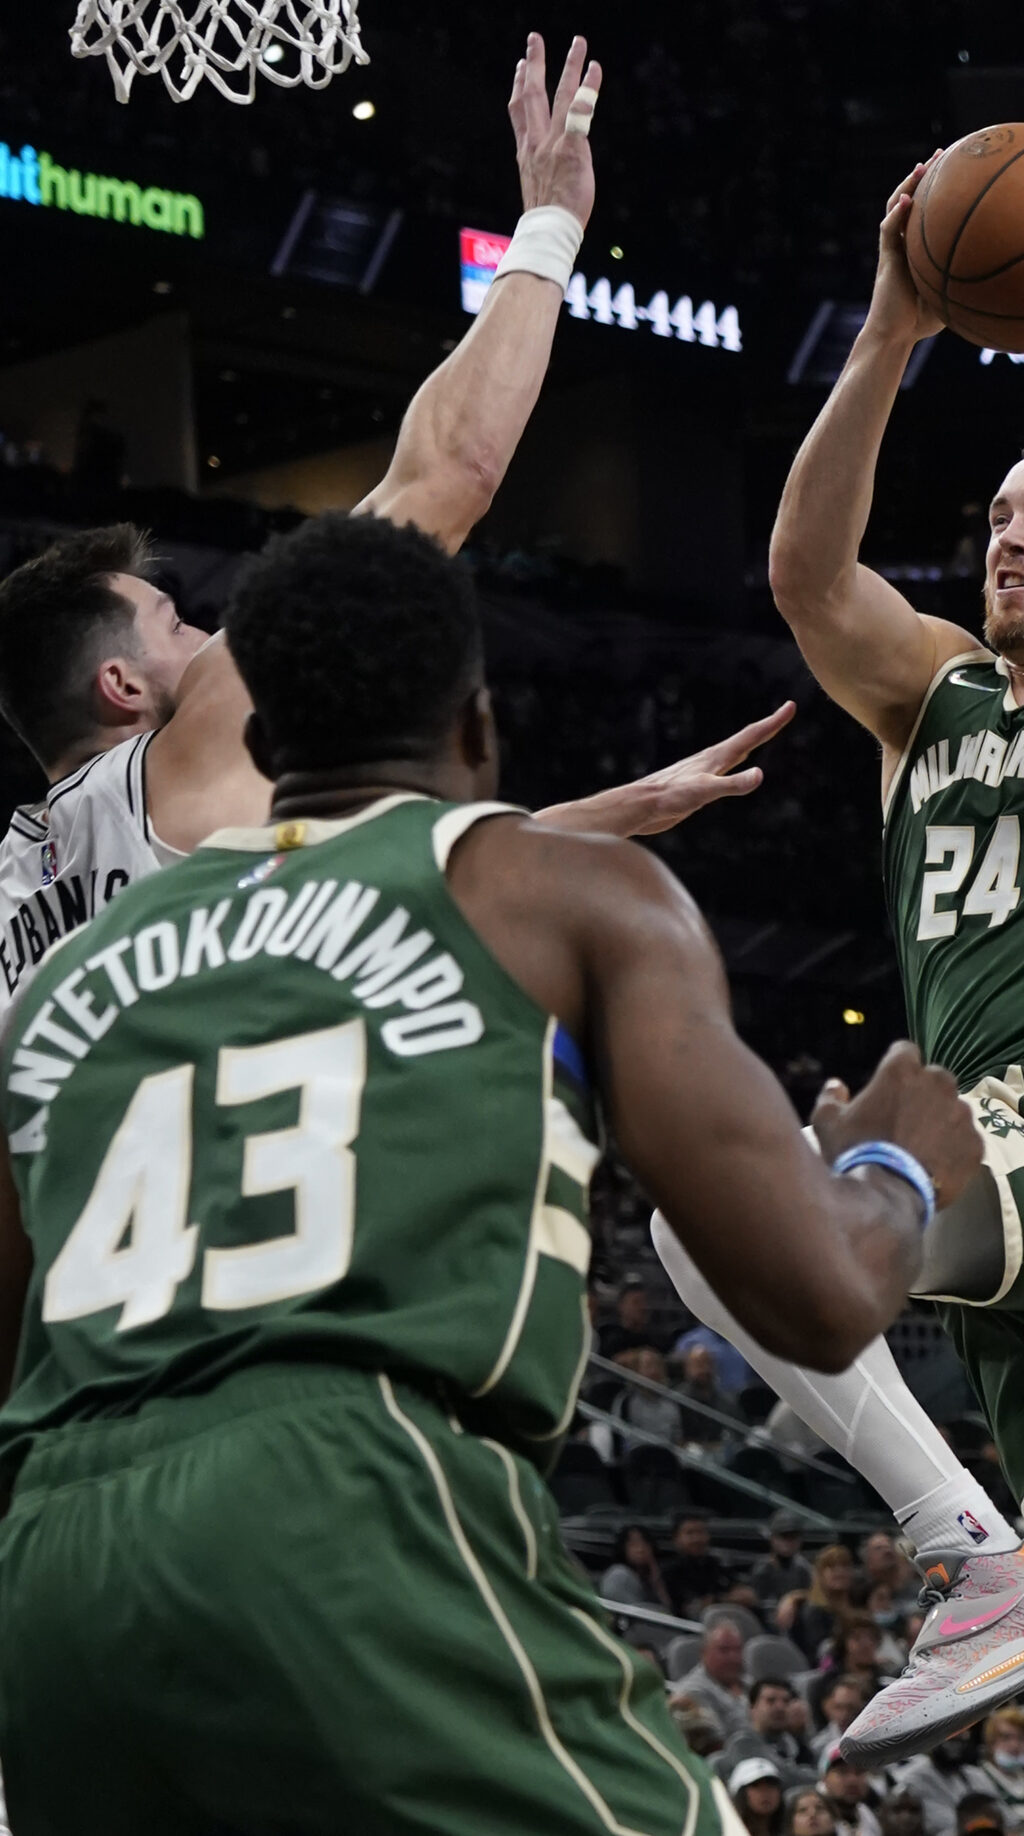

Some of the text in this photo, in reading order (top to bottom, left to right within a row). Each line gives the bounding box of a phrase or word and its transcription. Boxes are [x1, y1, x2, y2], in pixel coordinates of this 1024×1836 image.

[916, 815, 1021, 941] 24
[7, 879, 485, 1153] ANTETOKOUNMPO
[42, 1017, 366, 1332] 43
